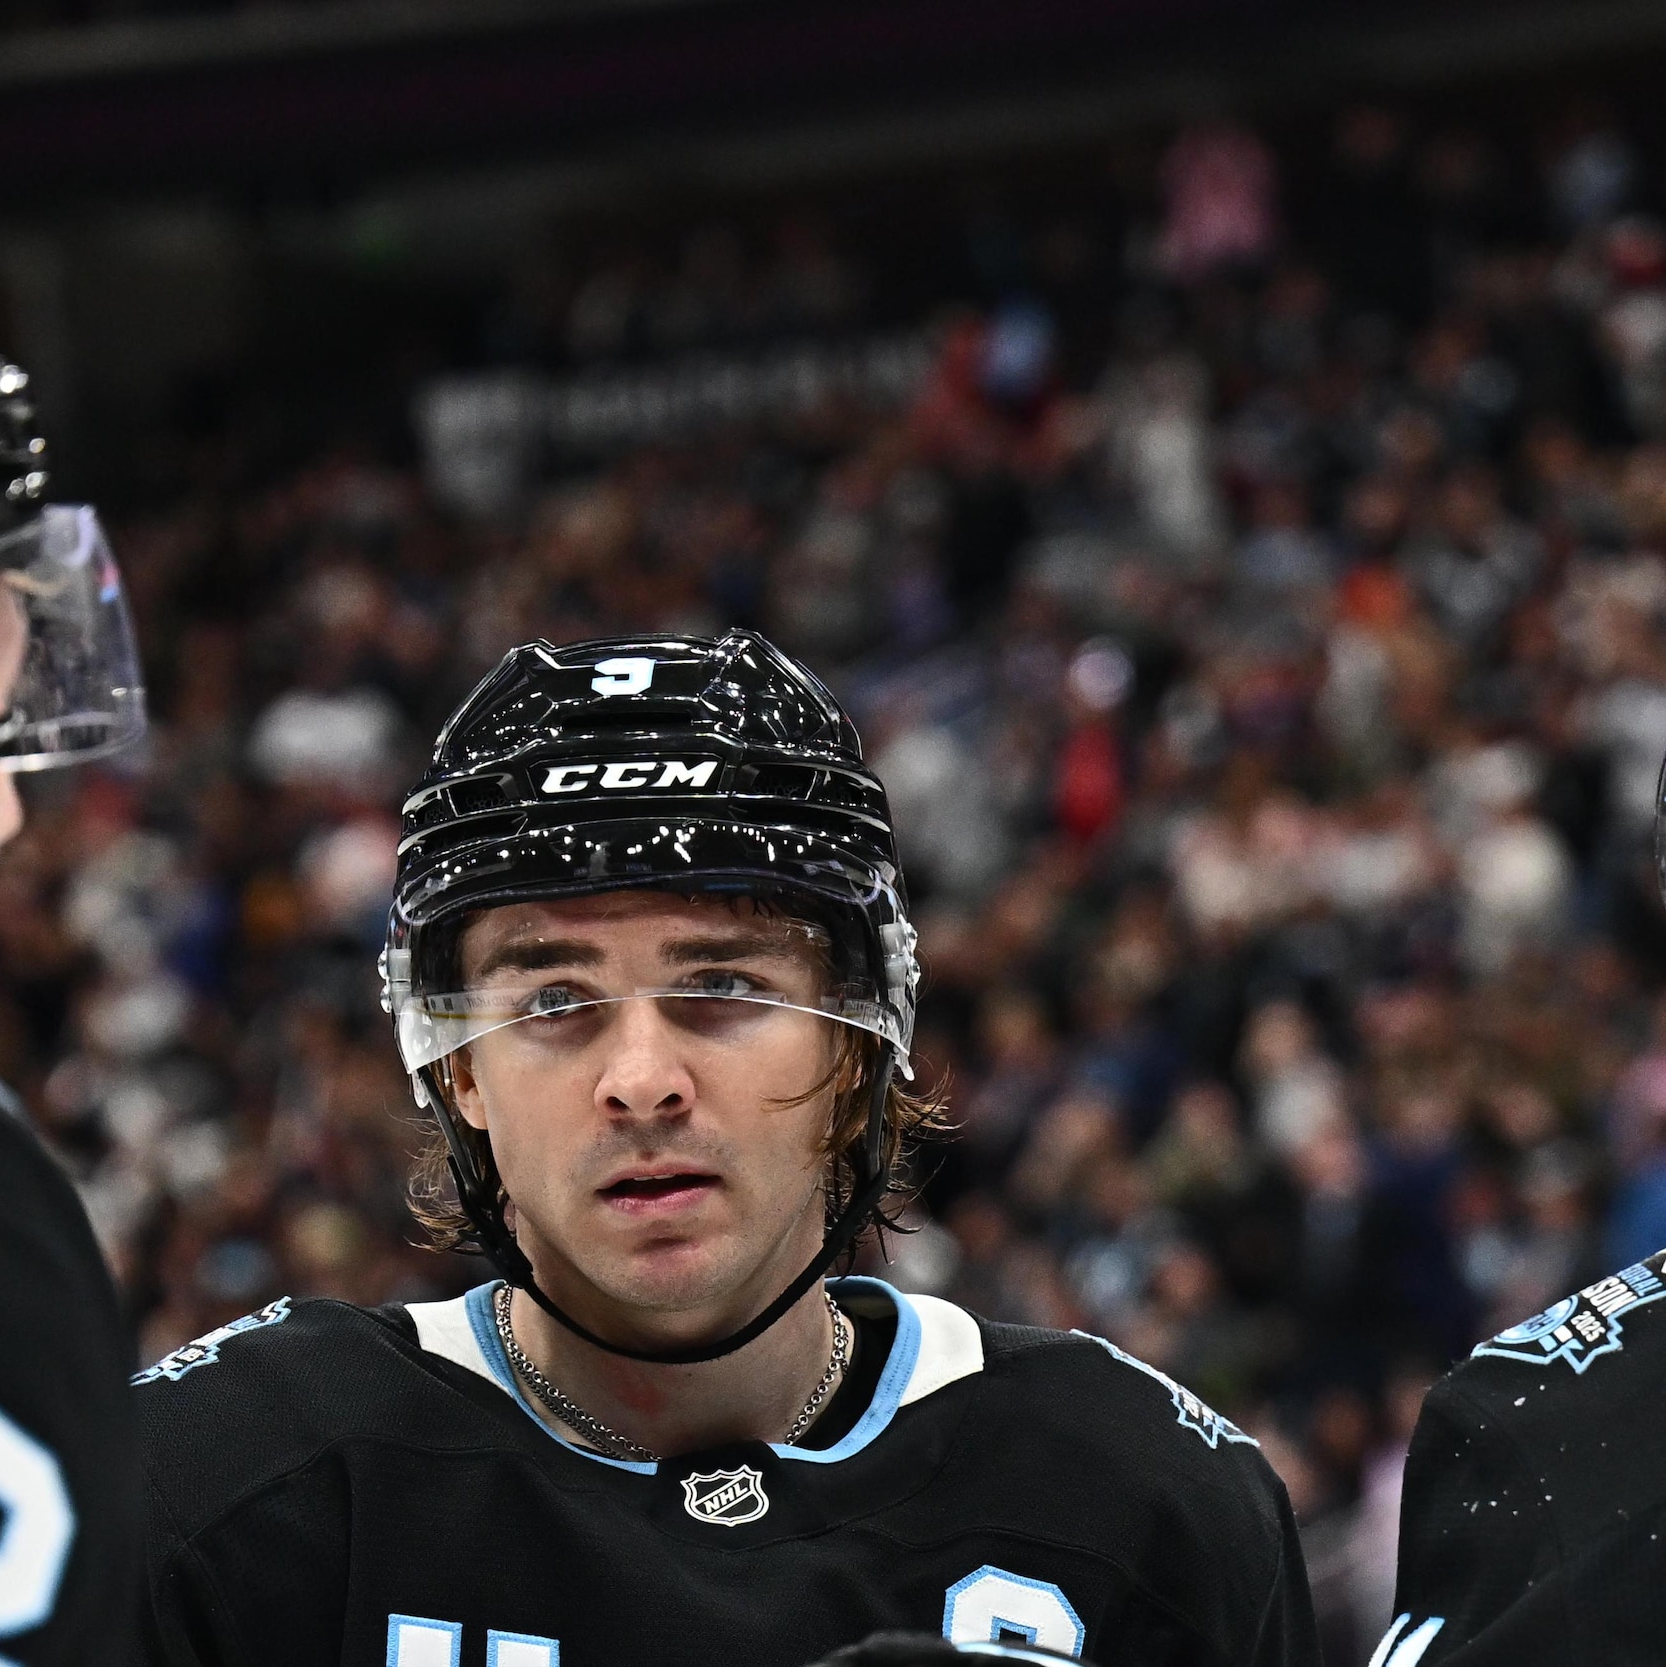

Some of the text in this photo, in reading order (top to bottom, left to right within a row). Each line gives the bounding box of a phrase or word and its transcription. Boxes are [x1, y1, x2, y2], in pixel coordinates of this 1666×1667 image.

[591, 657, 655, 696] 9
[542, 760, 718, 794] CCM
[1570, 1309, 1606, 1342] 2025
[703, 1482, 749, 1515] NHL
